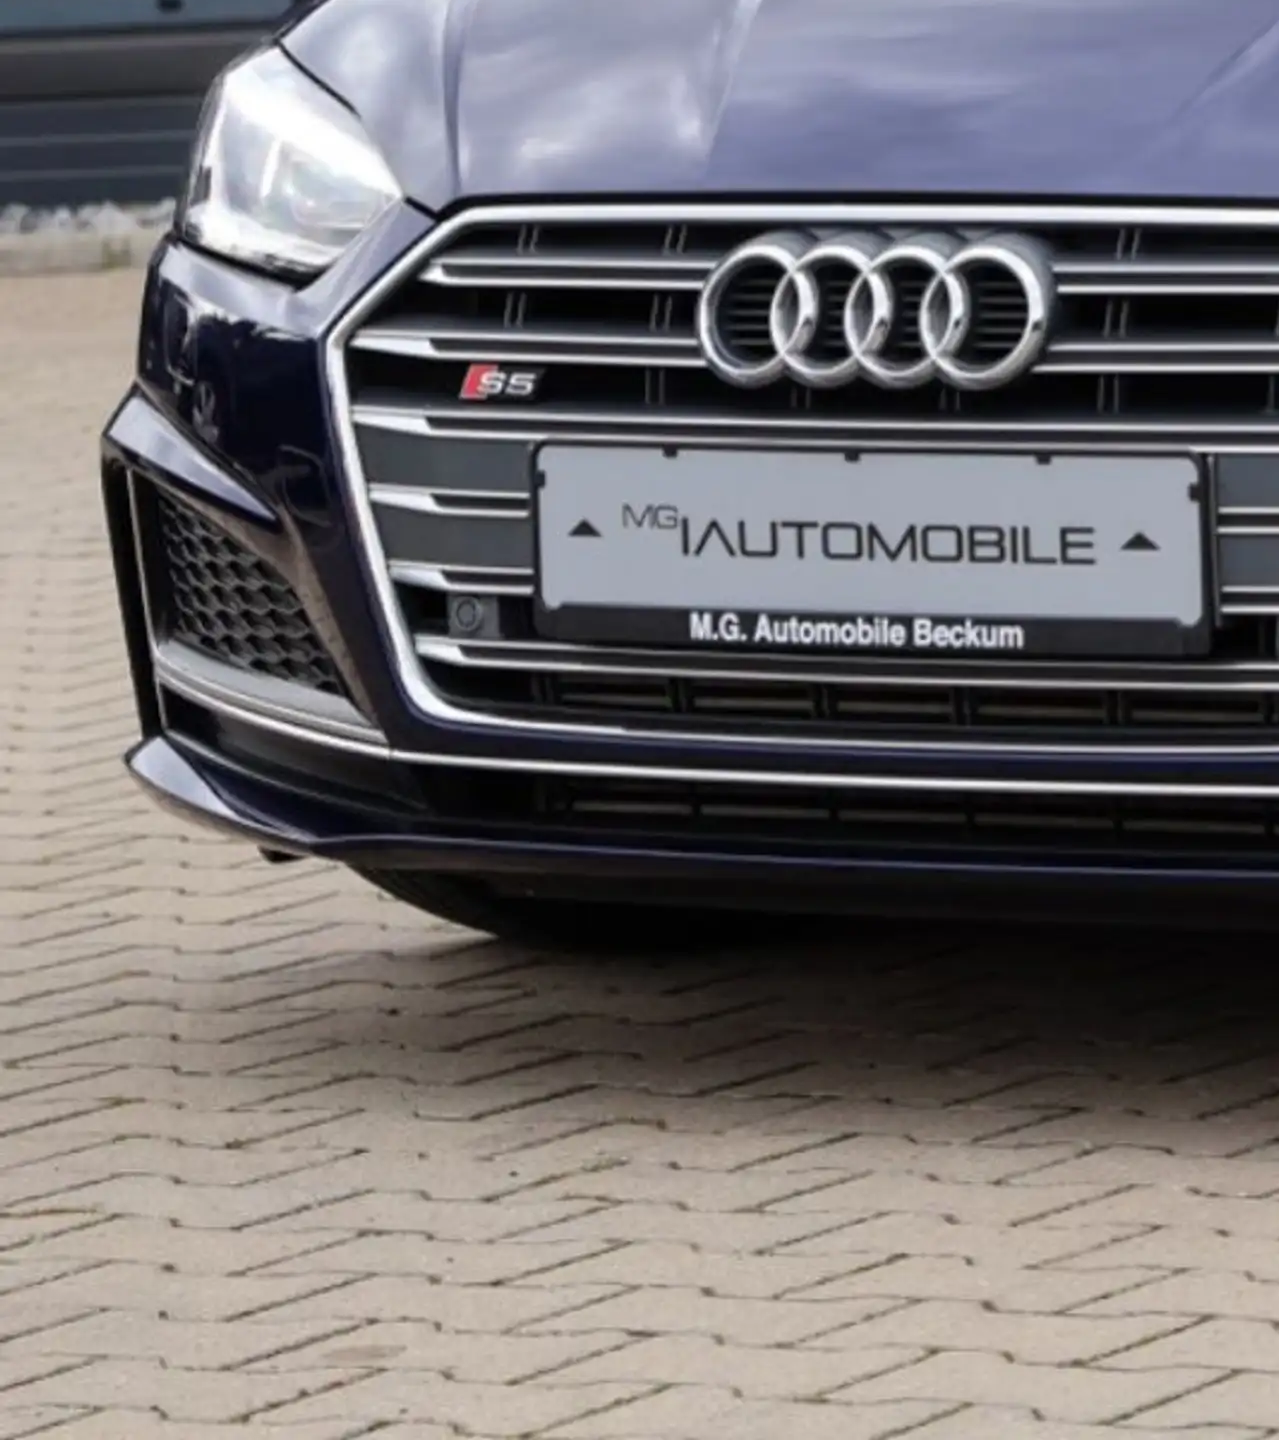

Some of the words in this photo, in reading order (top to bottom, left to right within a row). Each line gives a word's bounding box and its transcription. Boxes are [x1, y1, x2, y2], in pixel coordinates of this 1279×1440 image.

[474, 369, 539, 397] S5
[621, 504, 679, 530] MG
[689, 611, 748, 643] M.G.
[753, 614, 907, 647] Automobile
[912, 618, 1025, 650] Beckum
